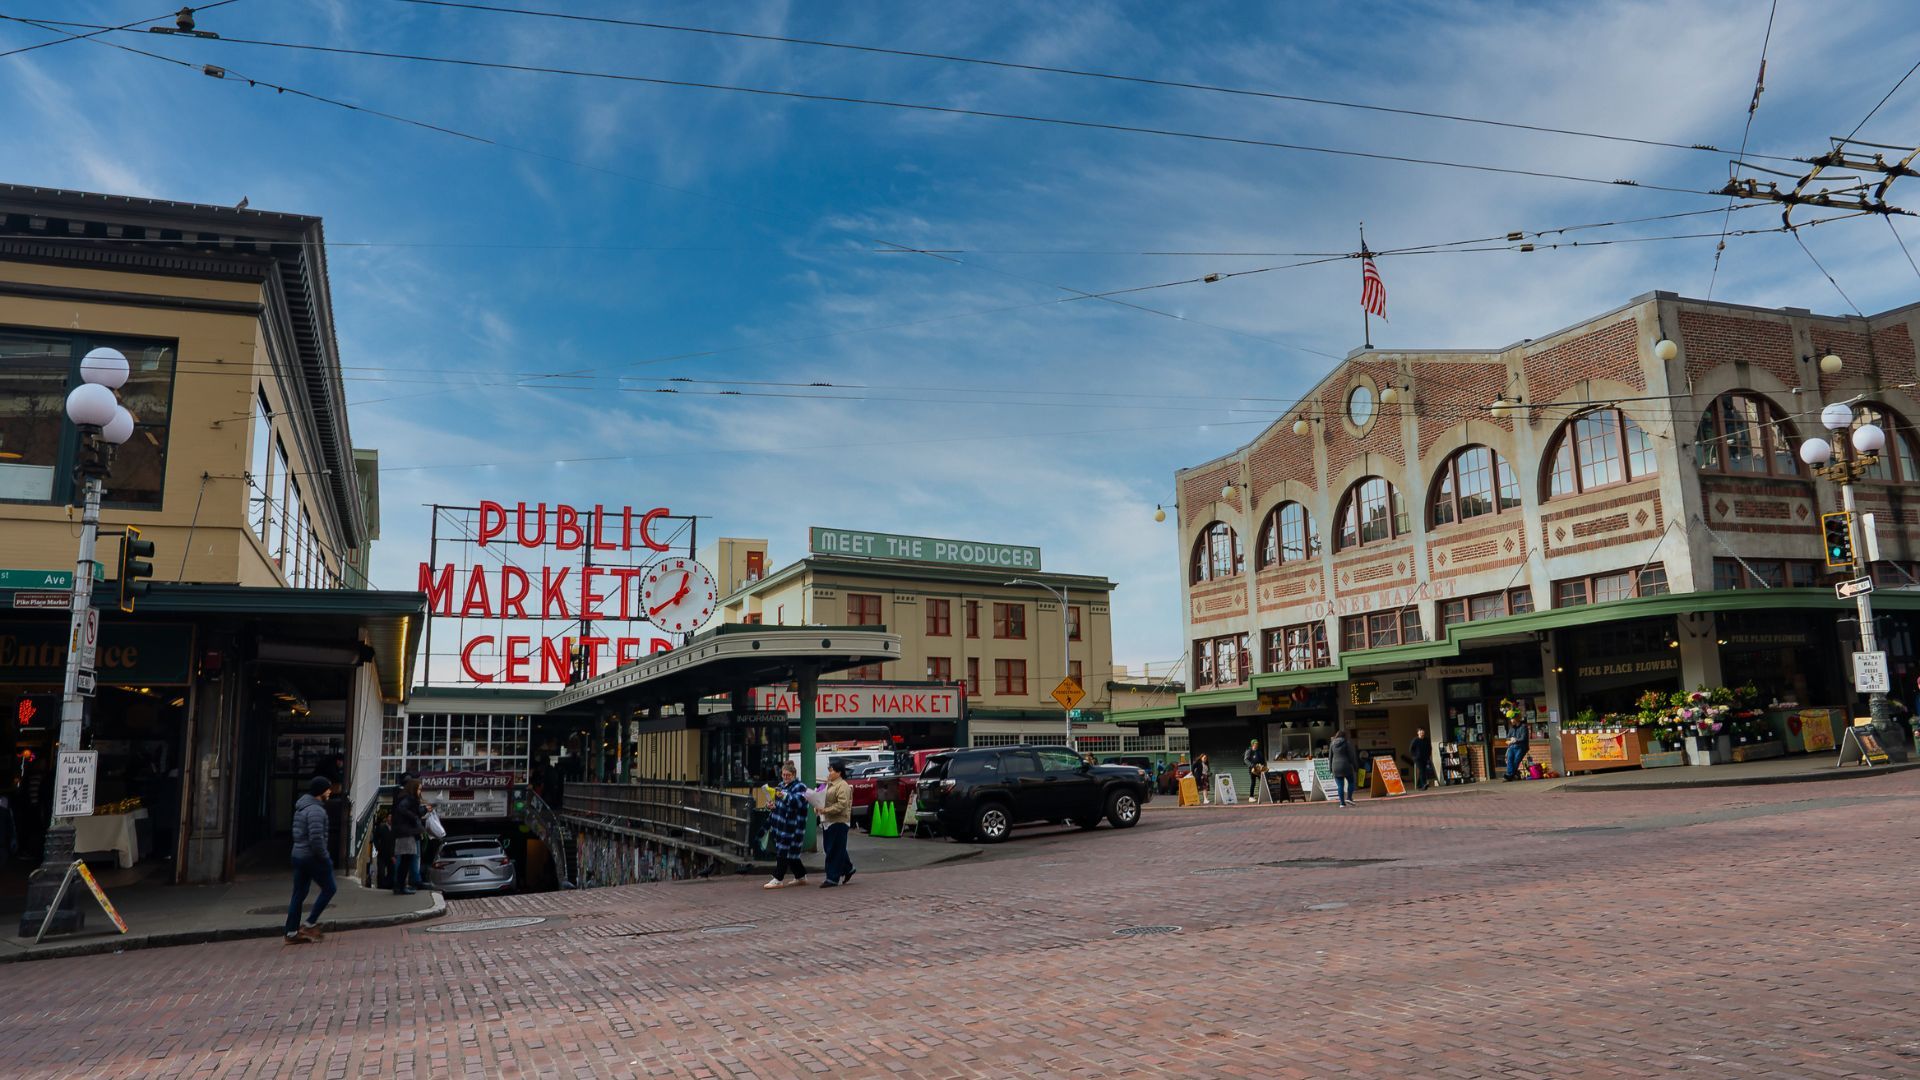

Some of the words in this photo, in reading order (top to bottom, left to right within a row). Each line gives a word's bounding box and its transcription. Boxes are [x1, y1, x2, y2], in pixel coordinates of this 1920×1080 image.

[478, 500, 670, 552] PUBLIC
[821, 532, 875, 553] MEET
[886, 538, 921, 558] THE
[935, 543, 1034, 567] PRODUCER
[676, 560, 684, 568] 12
[44, 575, 66, 585] Ave
[649, 575, 657, 583] 10
[418, 562, 641, 620] MARKET
[707, 592, 713, 600] 3
[1304, 600, 1373, 620] CORNER
[1378, 579, 1458, 608] MARKET
[0, 634, 139, 669] Entrce
[1578, 665, 1601, 677] PIKE
[1603, 663, 1632, 675] PLACE
[1636, 658, 1679, 673] FLOWERS
[873, 694, 952, 714] MARKET
[63, 756, 77, 765] ALL
[78, 755, 93, 763] WAY
[68, 766, 87, 774] WALK
[422, 777, 461, 787] MARKET
[464, 777, 507, 786] THEATER
